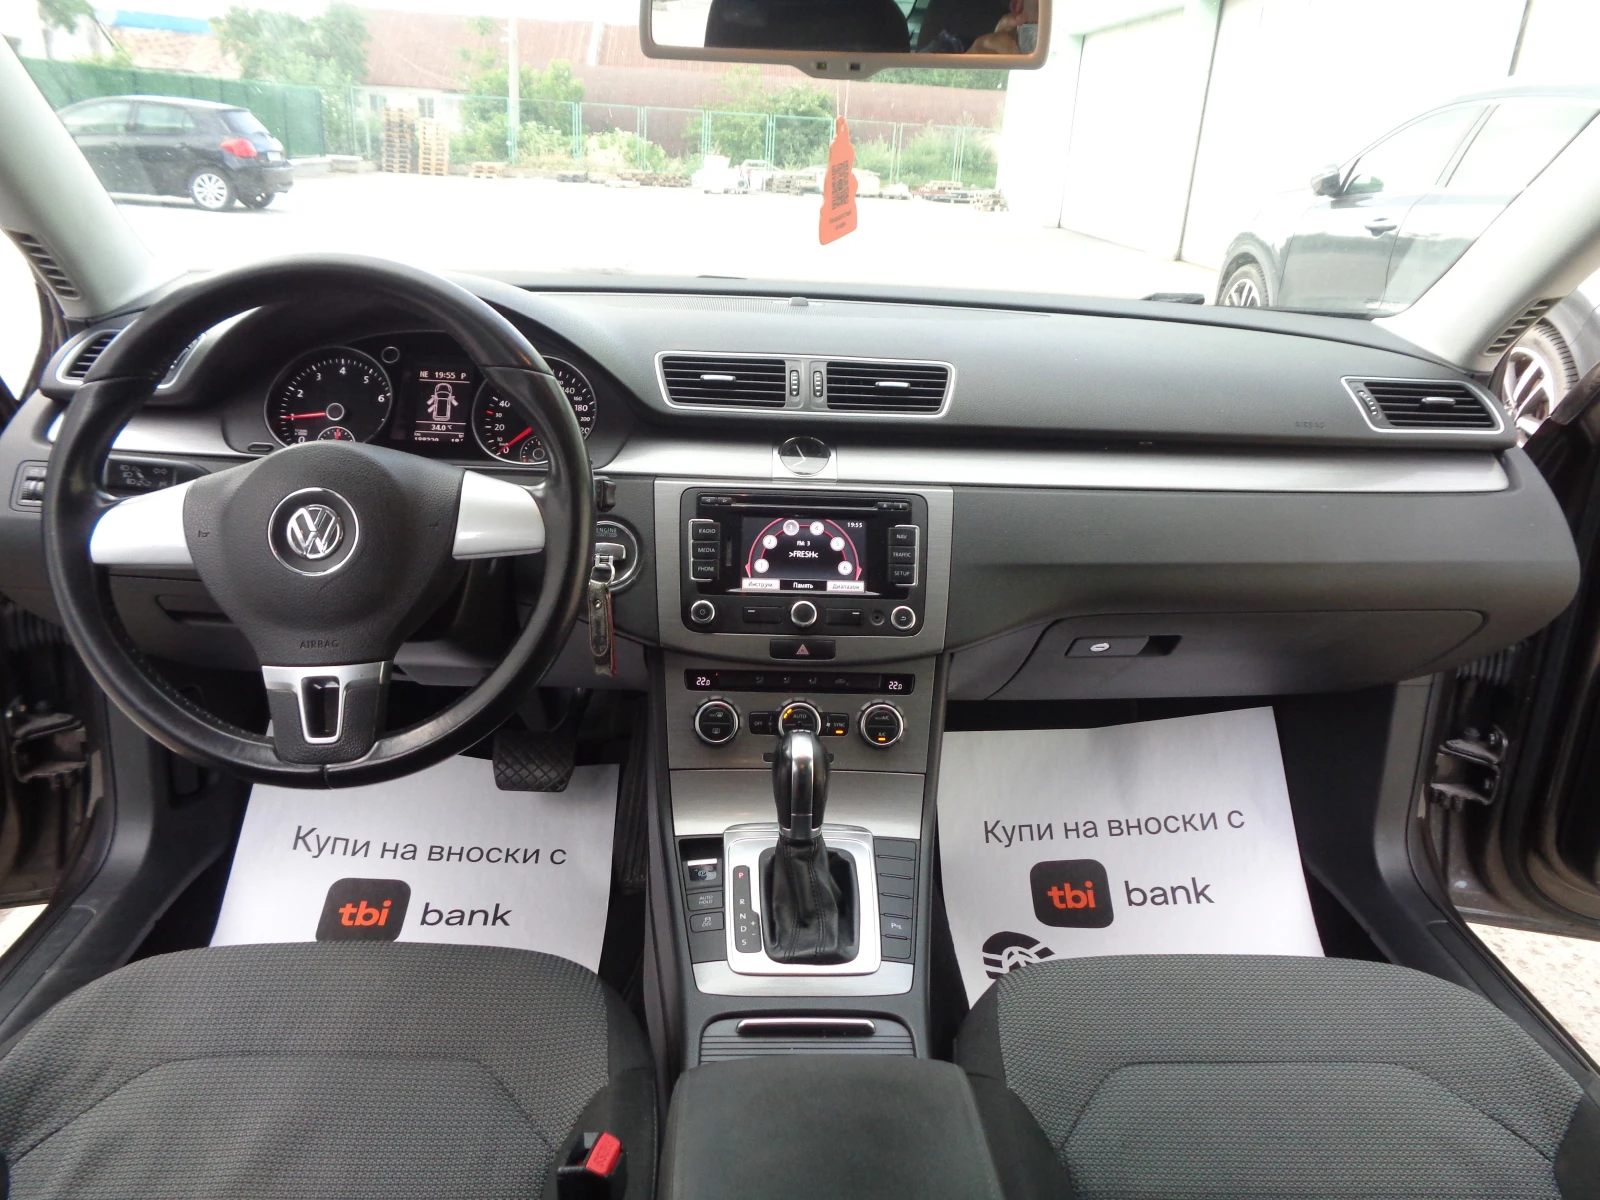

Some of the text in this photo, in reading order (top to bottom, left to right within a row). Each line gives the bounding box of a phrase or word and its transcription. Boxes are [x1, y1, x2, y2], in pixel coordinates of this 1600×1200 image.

[339, 366, 346, 375] 4
[316, 372, 322, 380] 3
[364, 376, 369, 384] 5
[297, 390, 304, 398] 2
[378, 394, 384, 402] 6
[300, 640, 339, 650] AIRBAG
[984, 810, 1245, 848] Купи на вноски с
[292, 825, 567, 865] Купи на вноски с
[1048, 877, 1216, 909] tbi bank
[338, 900, 512, 927] tbi bank
